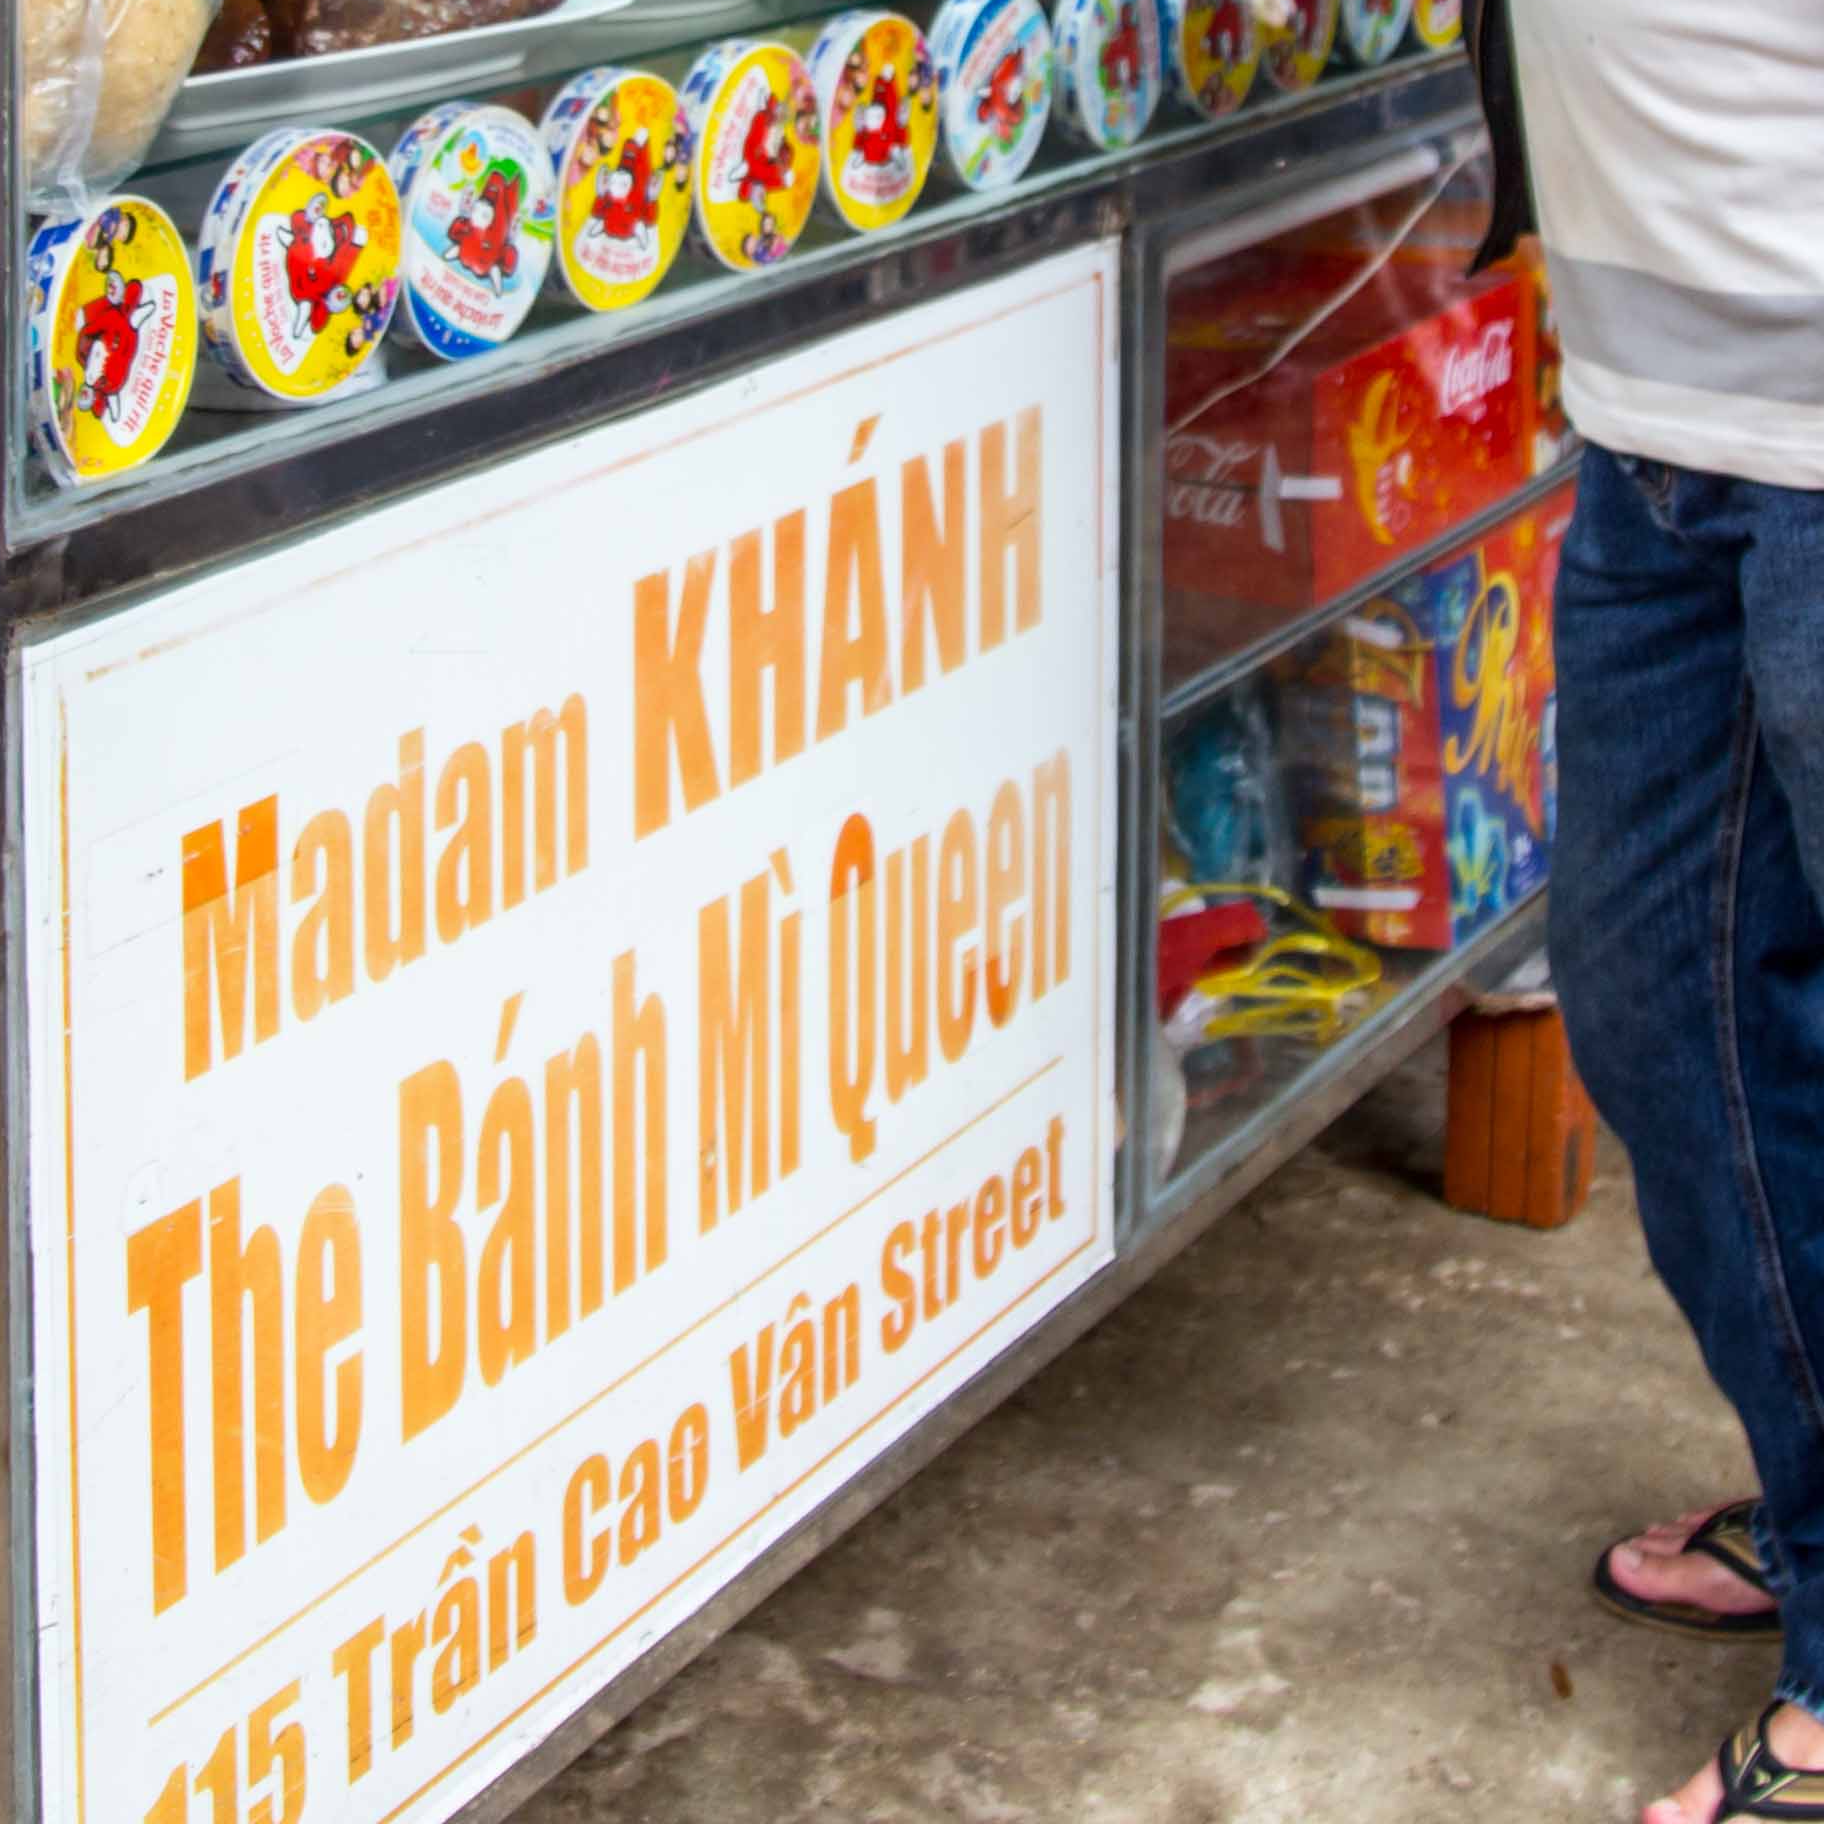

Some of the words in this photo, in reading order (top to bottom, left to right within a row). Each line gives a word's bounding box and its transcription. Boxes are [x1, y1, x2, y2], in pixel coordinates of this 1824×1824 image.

[179, 692, 589, 1084] Madam
[632, 410, 1043, 841] KHÁNH
[125, 1176, 365, 1618] The
[398, 950, 669, 1444] Bánh
[697, 847, 802, 1236] Mì
[827, 746, 1075, 1167] Queen
[329, 1521, 538, 1787] Trần
[561, 1402, 710, 1609] Cao
[727, 1291, 862, 1475] Vân
[879, 1112, 1069, 1357] Street
